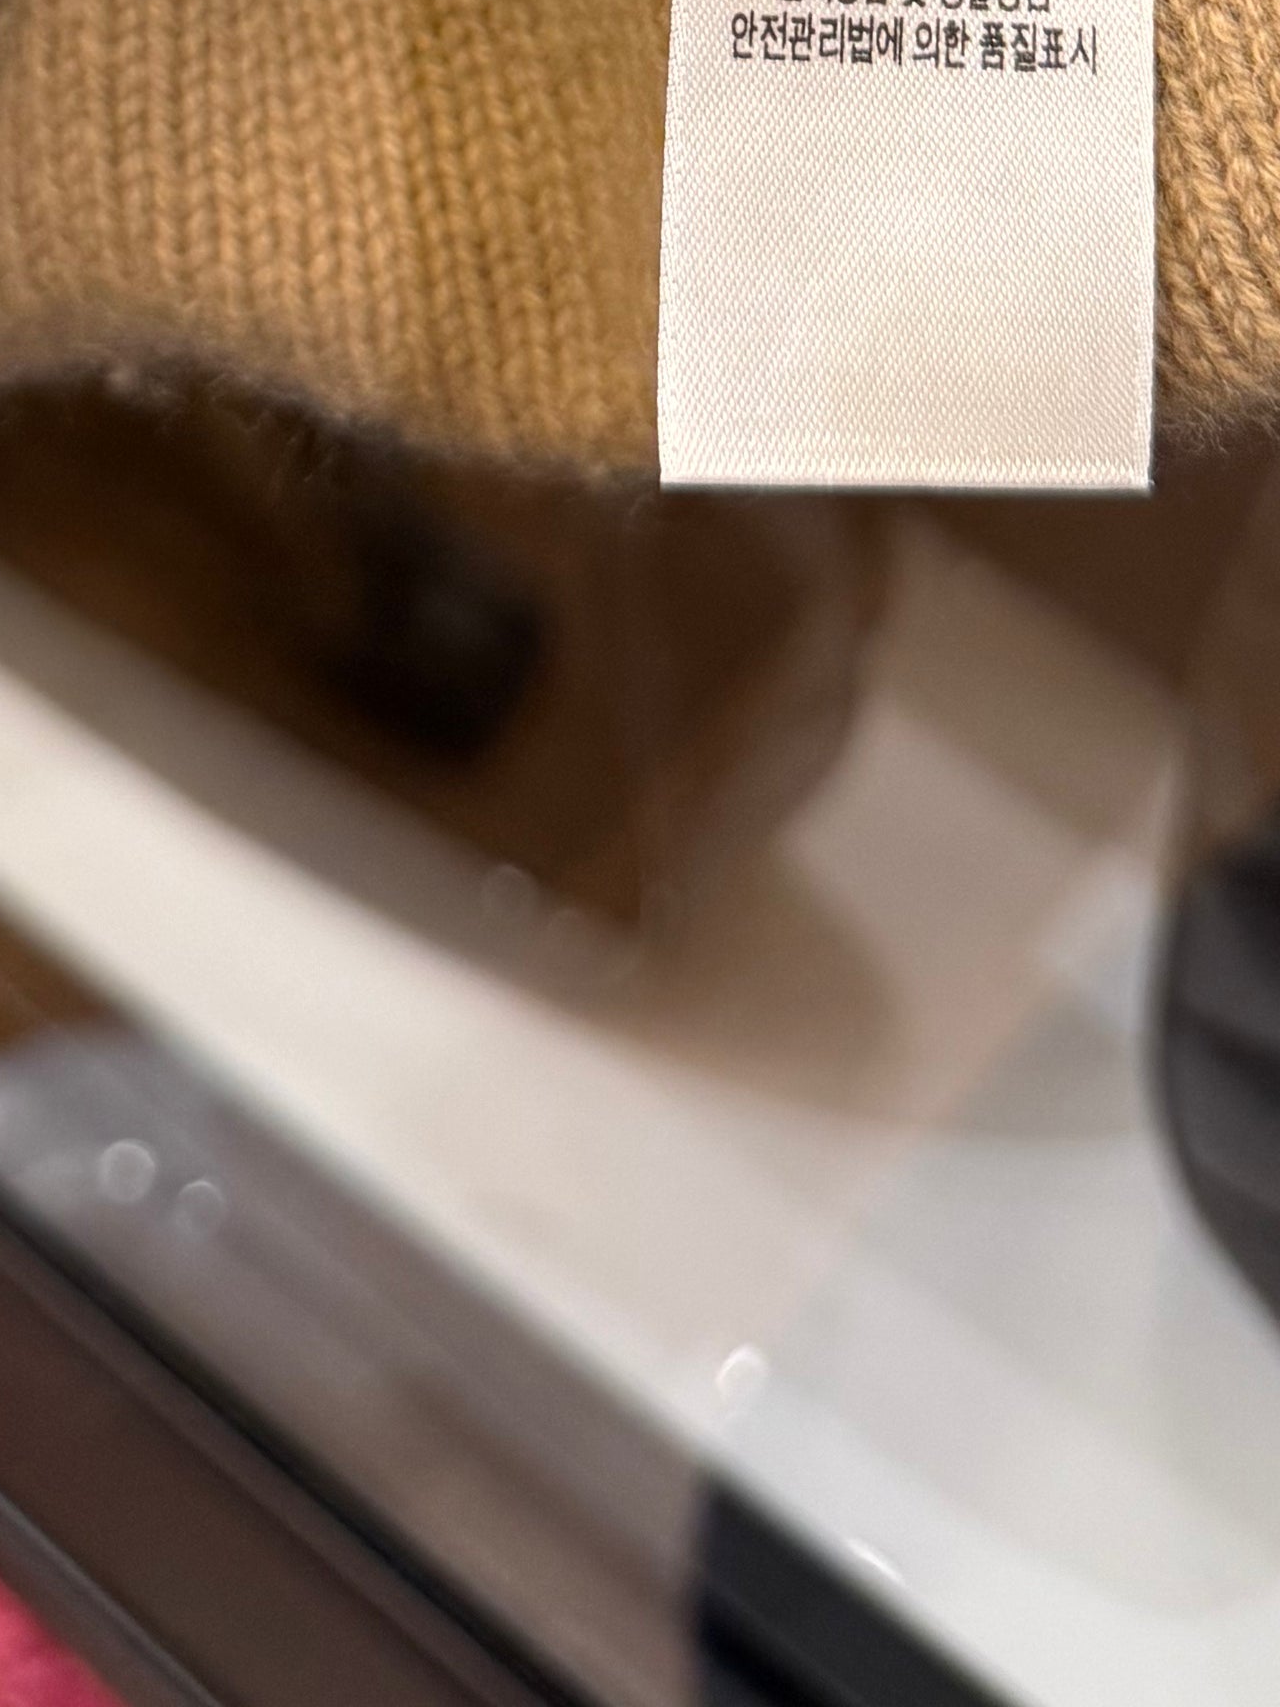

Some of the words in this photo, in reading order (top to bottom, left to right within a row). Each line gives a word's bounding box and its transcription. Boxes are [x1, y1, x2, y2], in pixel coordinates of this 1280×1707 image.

[731, 9, 904, 66] 안전관리법에
[913, 16, 970, 68] 의한
[980, 20, 1098, 75] 품질표시
